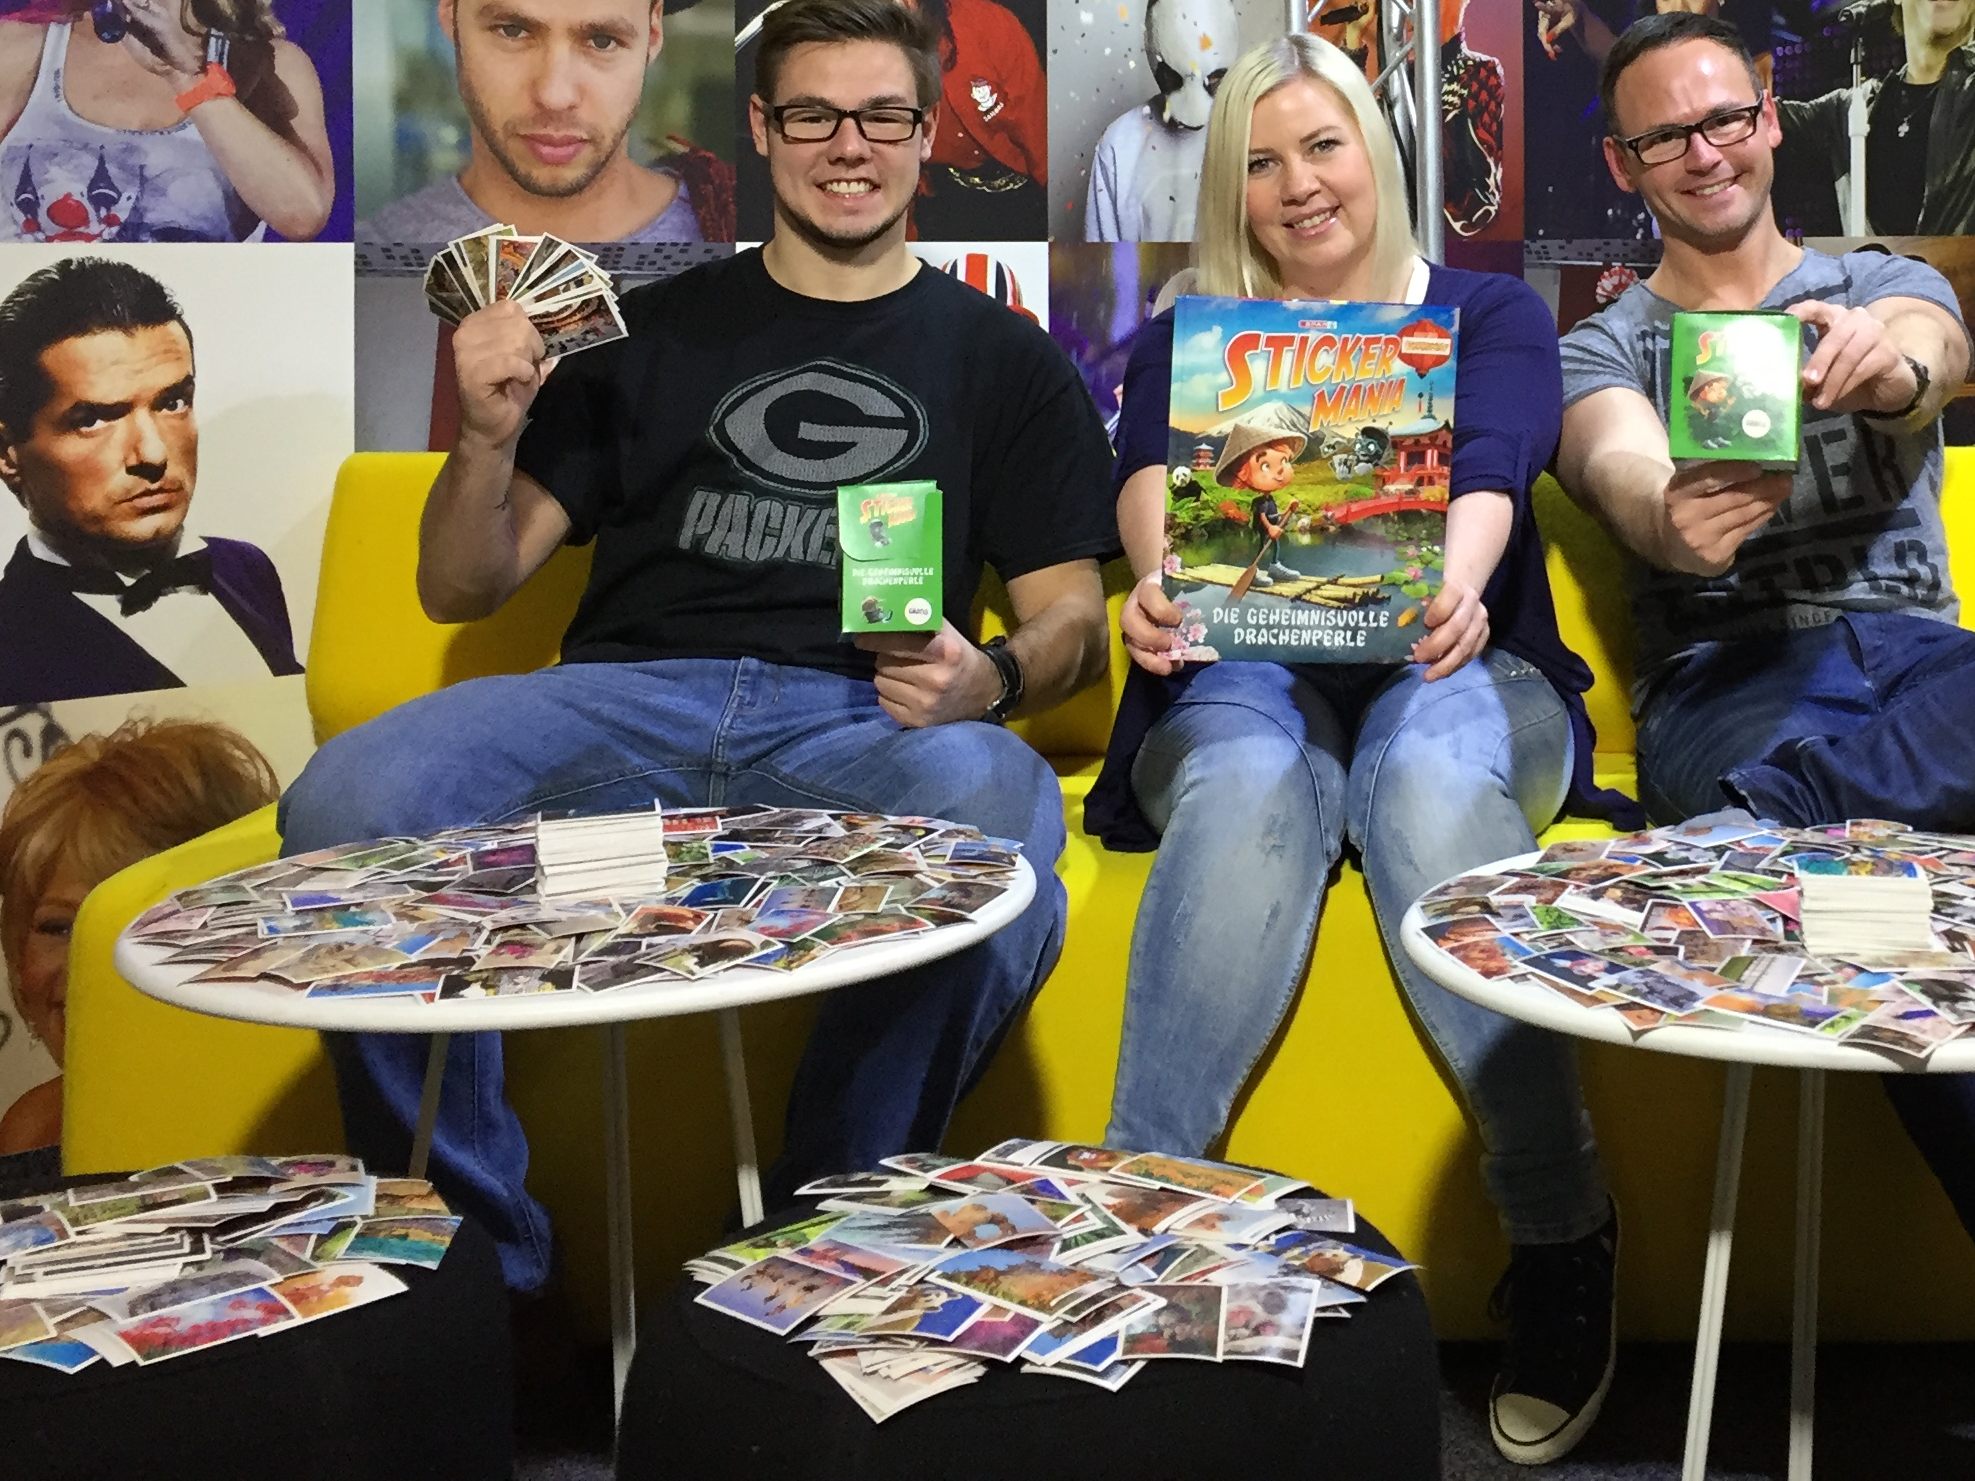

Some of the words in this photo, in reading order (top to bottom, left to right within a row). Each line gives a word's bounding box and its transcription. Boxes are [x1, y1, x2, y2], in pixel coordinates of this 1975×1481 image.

[1217, 330, 1400, 412] STICKER
[724, 371, 909, 482] G
[1309, 376, 1407, 432] MANIA
[678, 490, 839, 563] PACKE
[1212, 607, 1240, 624] DIE
[1246, 608, 1390, 628] GEHEIMNISVOLLE
[1234, 628, 1367, 647] DRACHENPERLE
